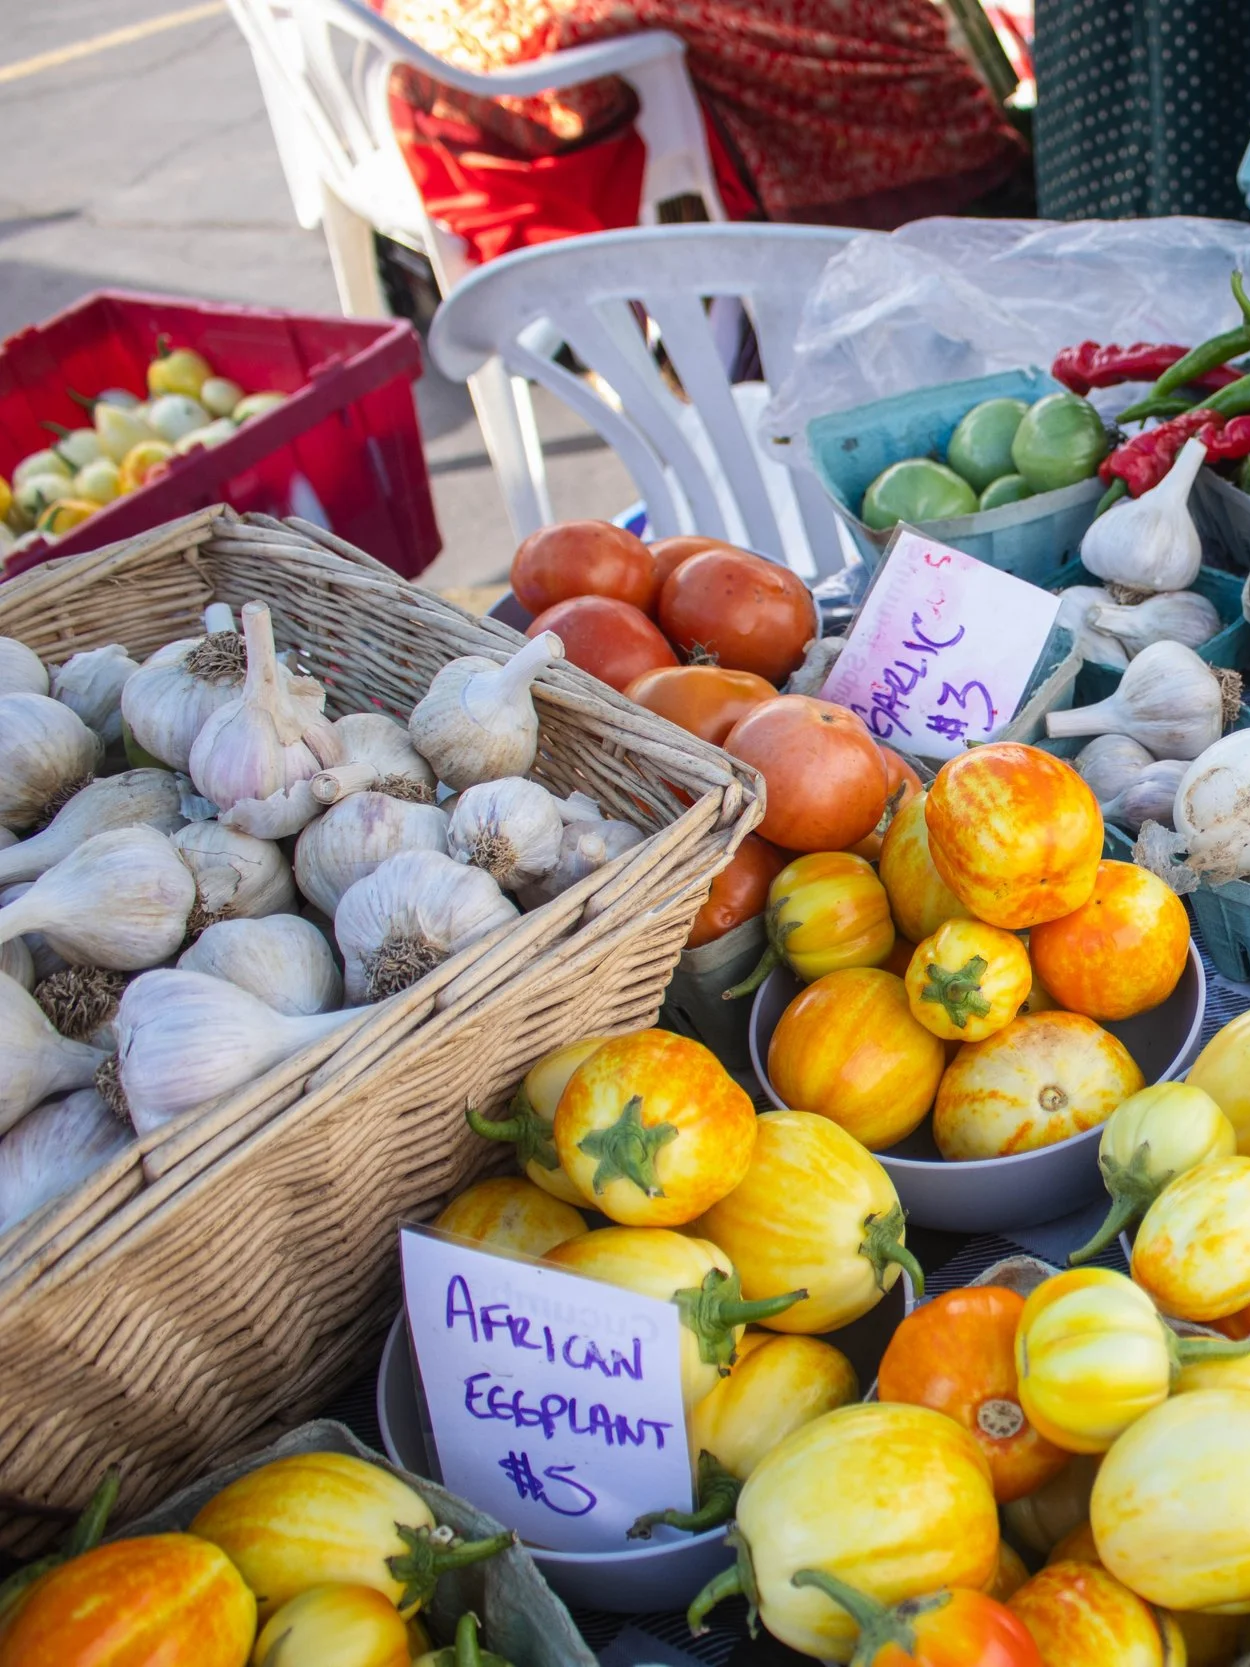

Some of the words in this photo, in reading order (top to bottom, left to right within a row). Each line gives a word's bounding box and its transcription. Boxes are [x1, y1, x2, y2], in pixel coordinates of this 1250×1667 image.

[850, 611, 965, 739] GARLIC
[446, 1275, 643, 1381] AFRICAN
[464, 1372, 674, 1450] EGGPLANT
